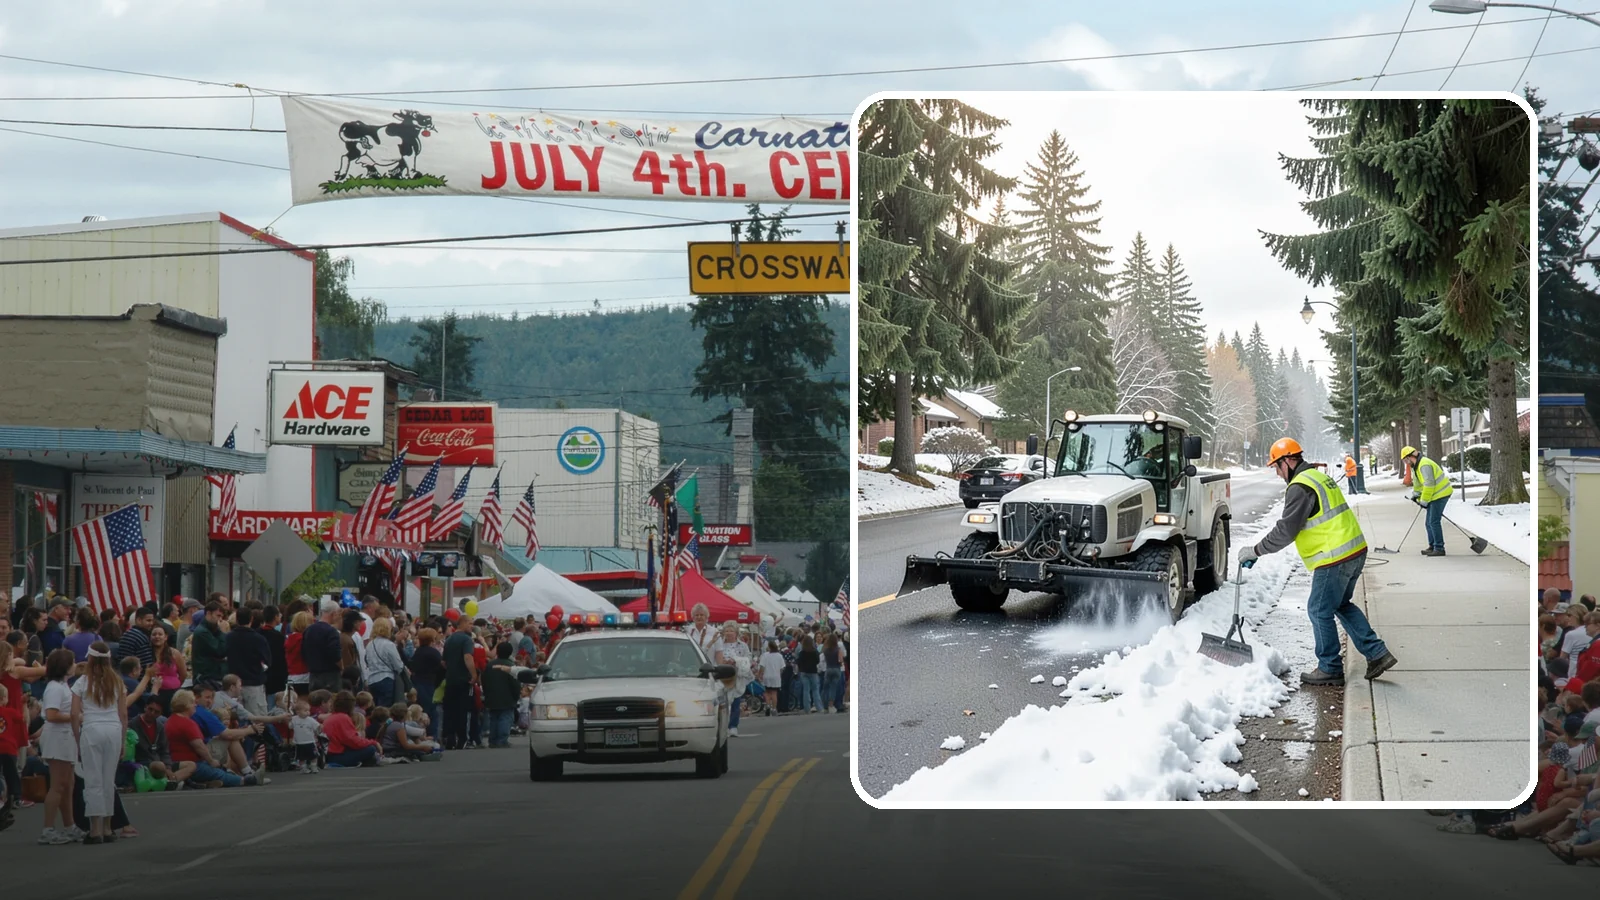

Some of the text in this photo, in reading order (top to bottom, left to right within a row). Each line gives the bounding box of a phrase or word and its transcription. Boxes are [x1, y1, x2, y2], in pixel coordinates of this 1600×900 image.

[695, 121, 850, 150] Carnat
[481, 141, 605, 192] JULY
[632, 150, 746, 198] 4th.
[697, 254, 850, 280] CROSSWA
[282, 380, 373, 420] ACE
[405, 409, 485, 422] CEDAR LOG
[283, 421, 371, 436] Hardware
[416, 428, 477, 447] Coca-Cola
[353, 466, 387, 480] Simpl
[83, 485, 155, 495] St. Vincent de Paul
[688, 526, 741, 535] CRNATION
[699, 535, 730, 543] GLASS
